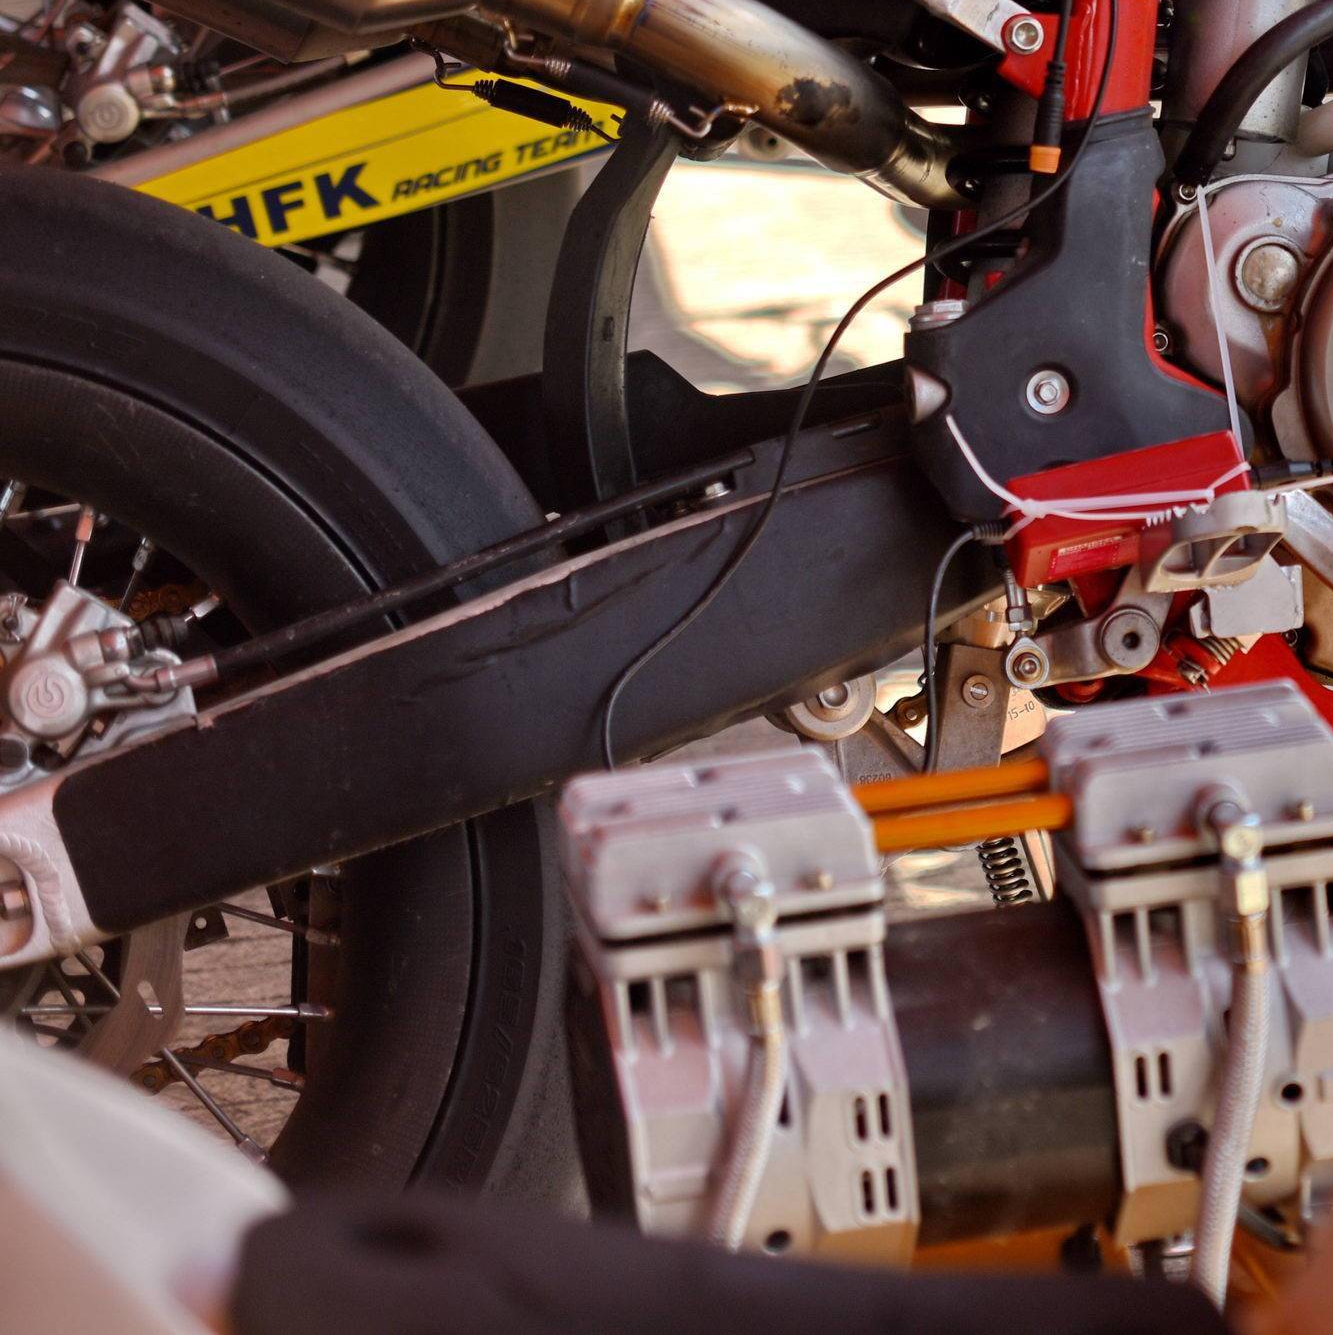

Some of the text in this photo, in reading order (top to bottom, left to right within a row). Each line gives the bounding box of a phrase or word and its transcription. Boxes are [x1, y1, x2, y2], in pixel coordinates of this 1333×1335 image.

[196, 121, 606, 240] HFK RACING TEAM
